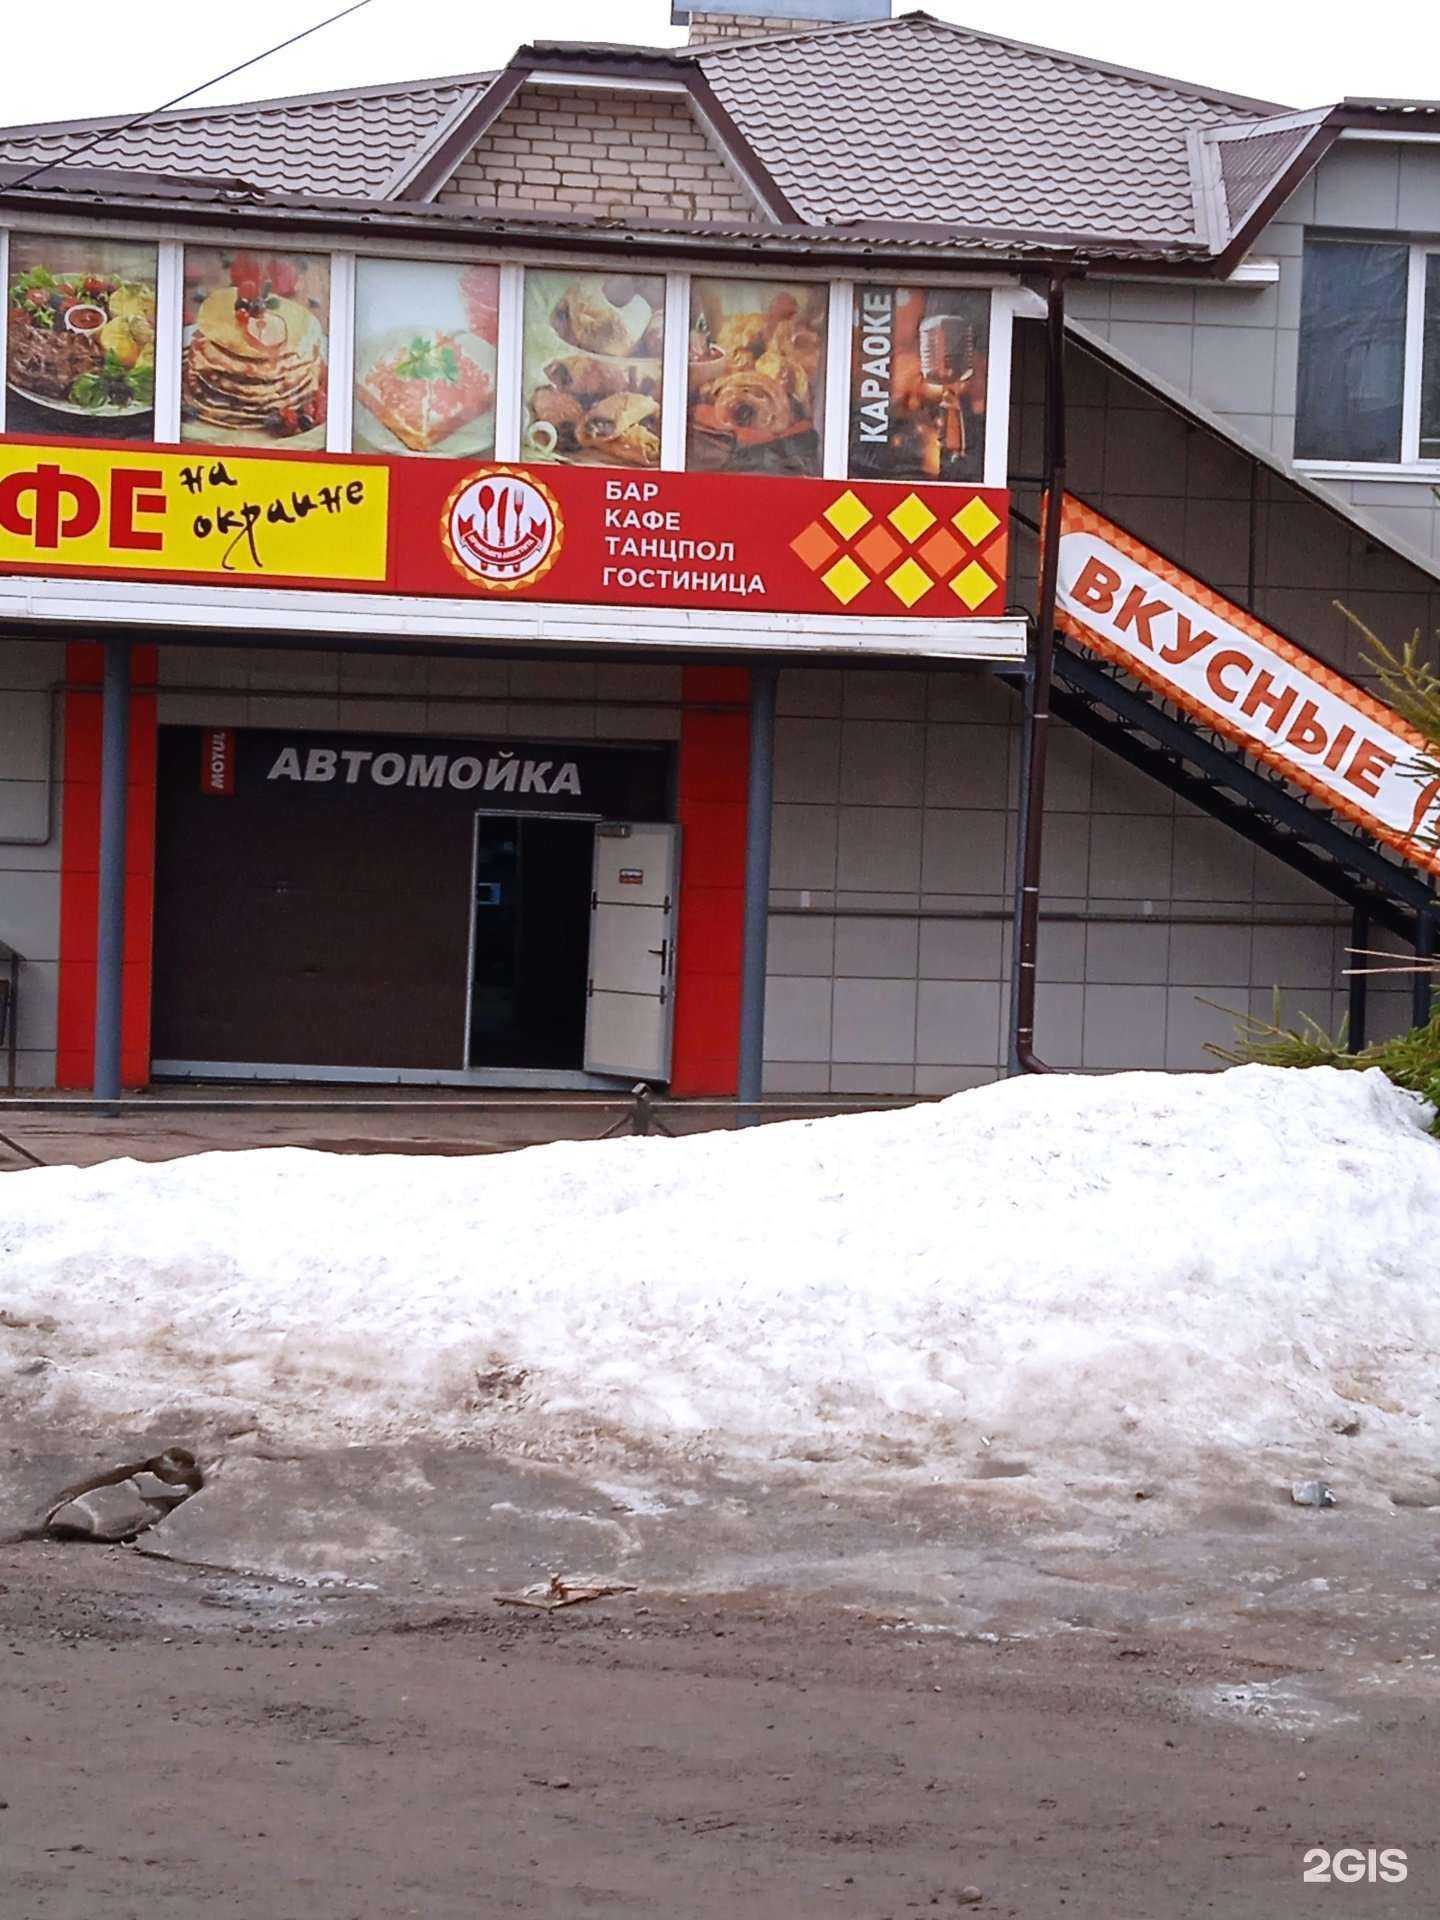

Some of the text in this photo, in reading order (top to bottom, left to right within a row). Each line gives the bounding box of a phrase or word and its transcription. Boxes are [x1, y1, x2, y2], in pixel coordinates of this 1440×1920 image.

[860, 292, 891, 442] КАРАОКЕ
[180, 462, 237, 493] на
[605, 480, 659, 502] БАР
[0, 464, 166, 551] ФЕ
[193, 481, 364, 570] окраине
[605, 508, 681, 531] КАФЕ
[605, 536, 735, 562] ТАНЦПОЛ
[603, 567, 766, 596] ГОСТИНИЦА
[1070, 555, 1396, 798] ВКУСНЫЕ
[267, 747, 582, 796] АВТОМОЙКА
